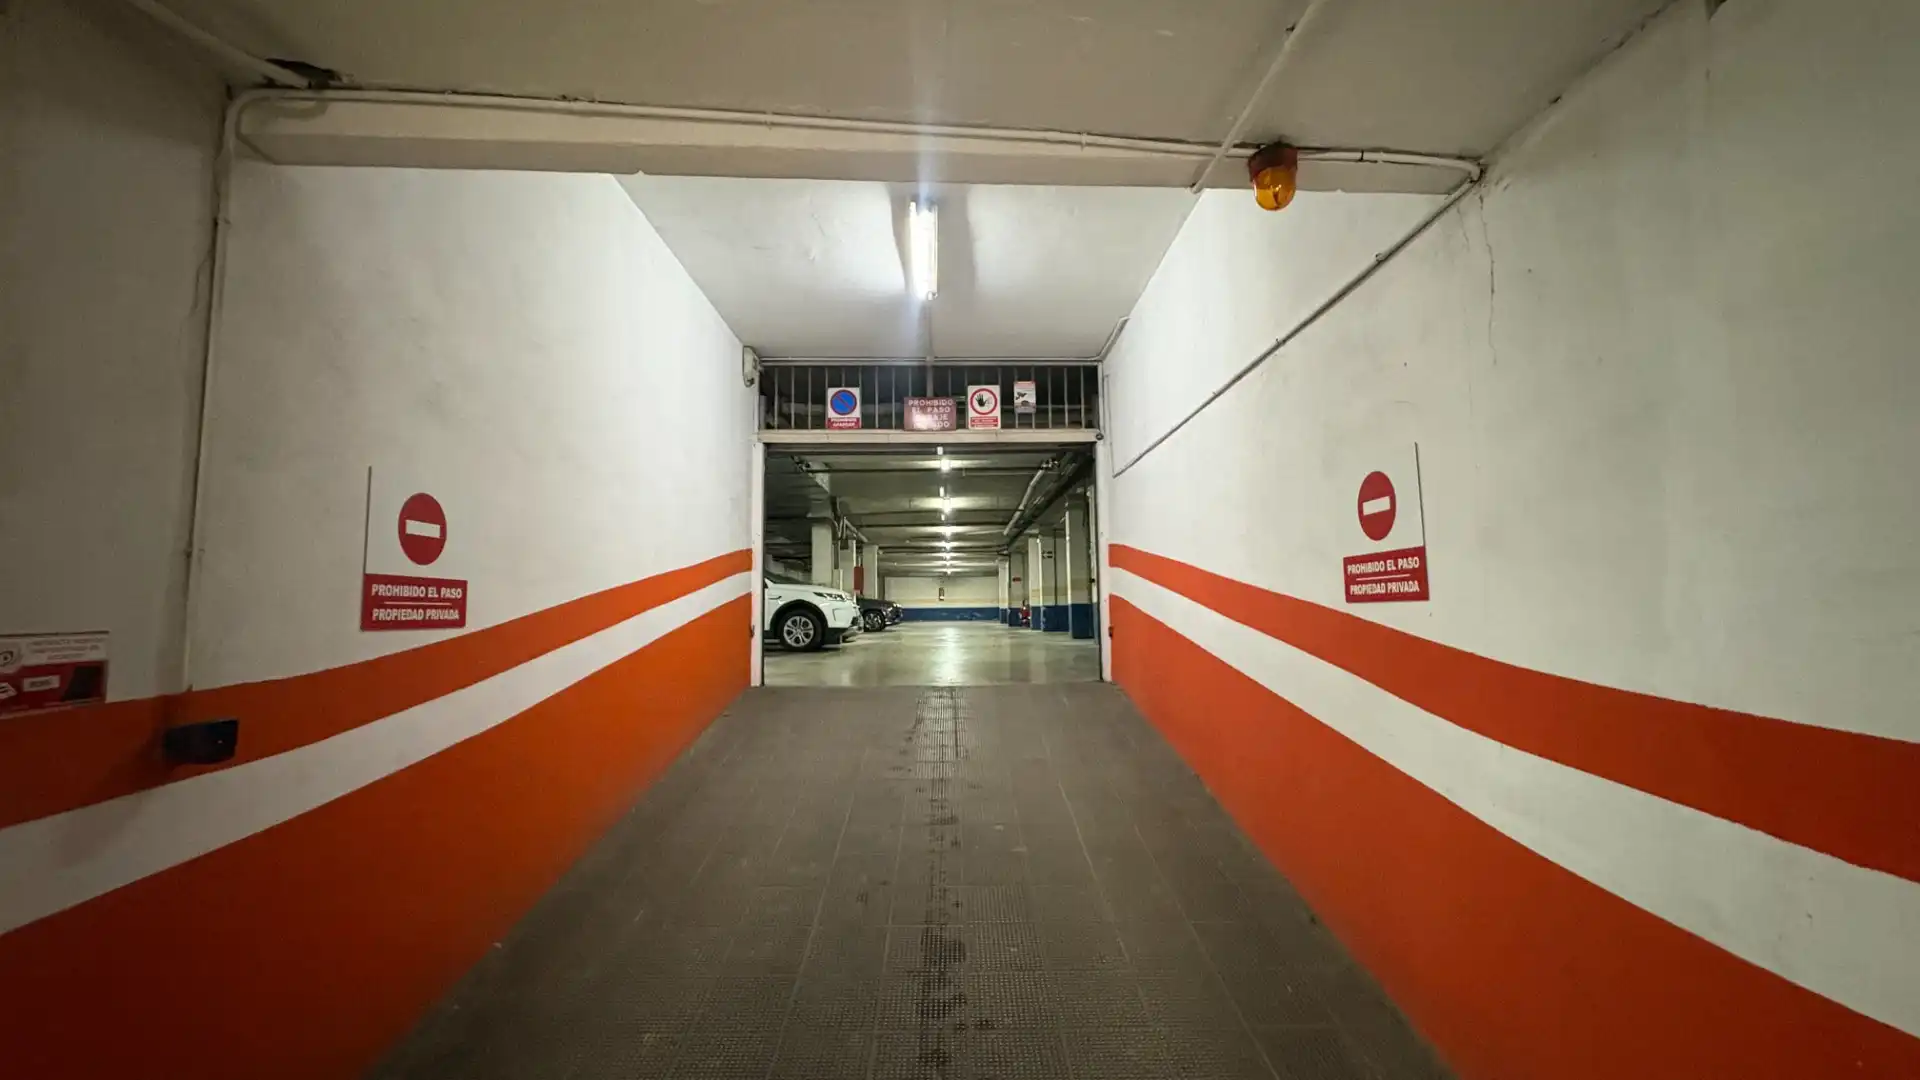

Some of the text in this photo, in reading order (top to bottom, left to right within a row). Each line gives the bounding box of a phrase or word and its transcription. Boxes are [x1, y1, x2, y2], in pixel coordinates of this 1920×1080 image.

[1347, 557, 1419, 575] PROHIBIDO EL PASO
[371, 583, 463, 599] PROHIBIDO EL PASO
[1350, 580, 1420, 596] PROPIEDAD PRIVADA
[372, 608, 460, 621] PROPIEDAD PRIVADA
